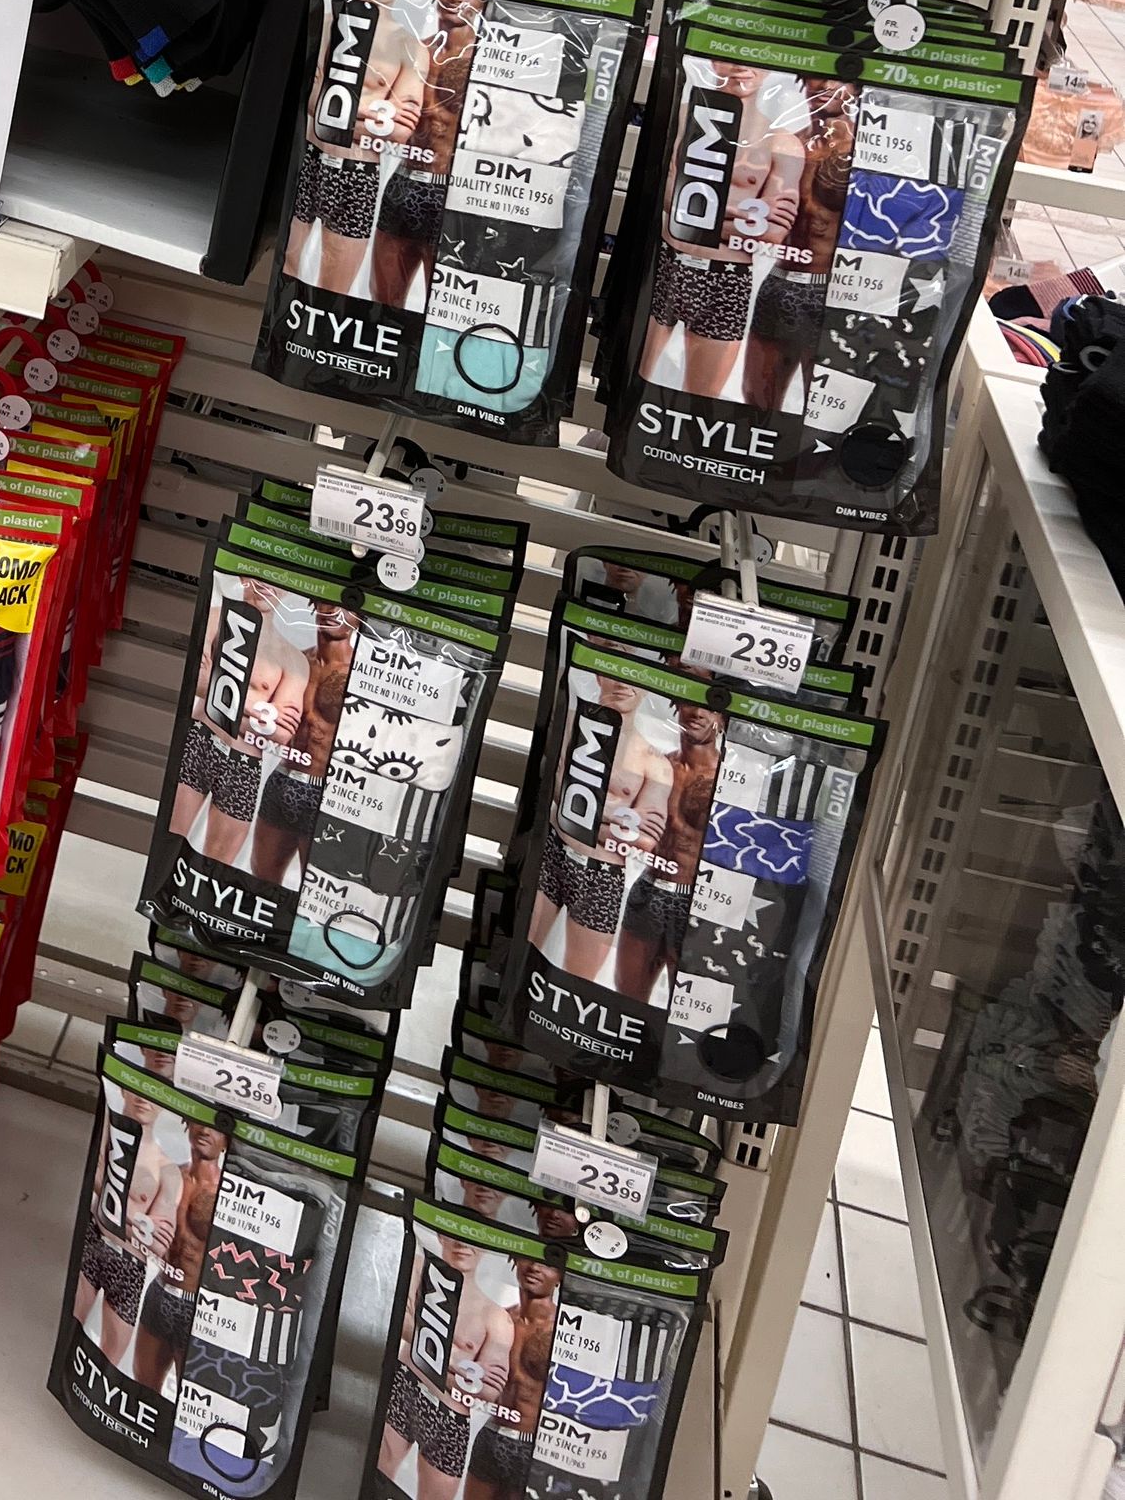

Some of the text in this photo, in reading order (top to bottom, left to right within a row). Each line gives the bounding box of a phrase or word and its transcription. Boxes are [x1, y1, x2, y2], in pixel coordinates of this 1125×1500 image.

[320, 13, 372, 130] DIM
[359, 135, 436, 164] BOXERS
[474, 159, 532, 184] DIM
[449, 174, 554, 205] QUALITY SINCE 1956
[286, 300, 402, 358] STYLE
[457, 404, 505, 426] DIM VIBES
[74, 1347, 159, 1433] STYLE
